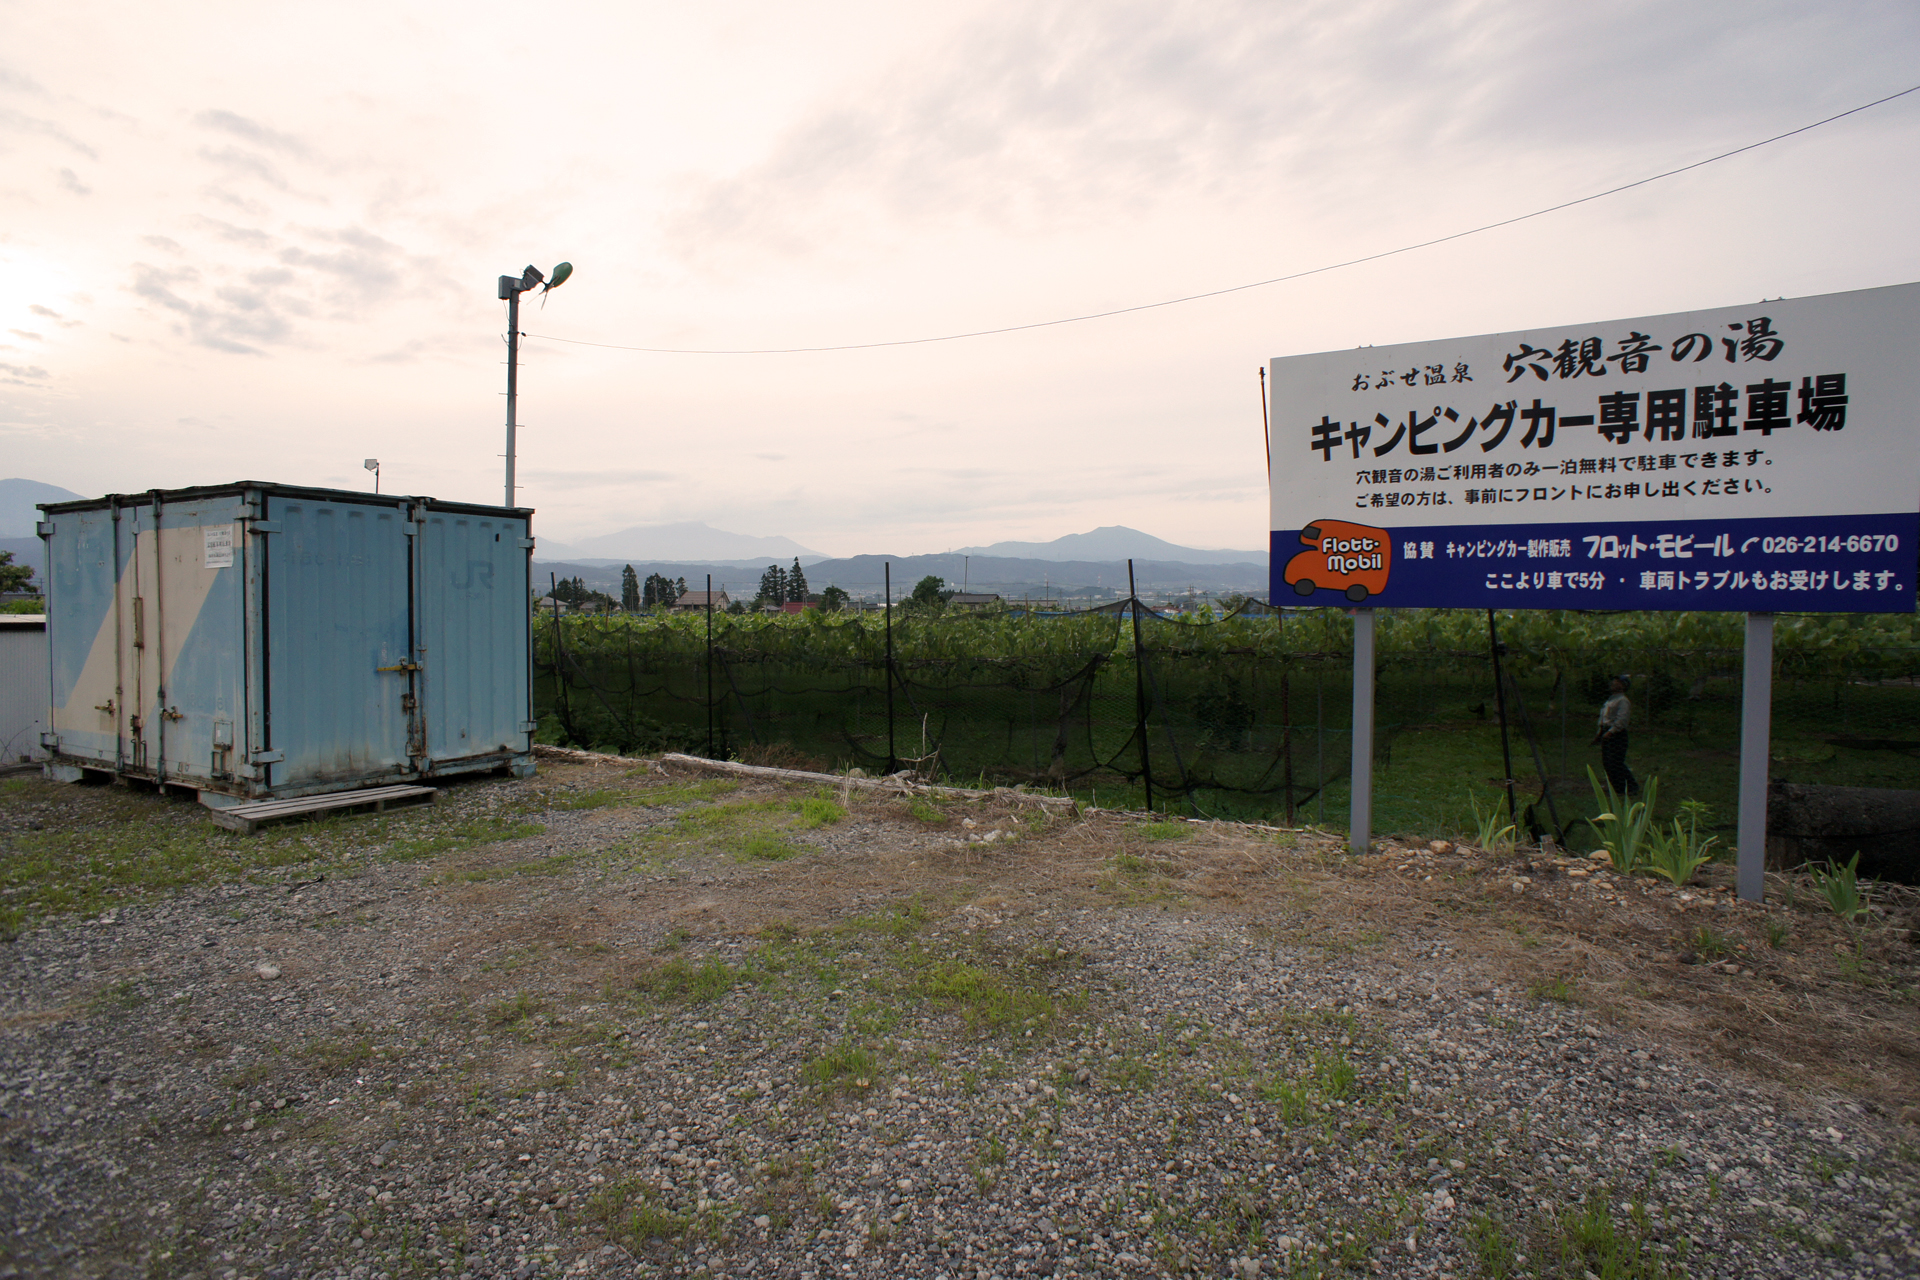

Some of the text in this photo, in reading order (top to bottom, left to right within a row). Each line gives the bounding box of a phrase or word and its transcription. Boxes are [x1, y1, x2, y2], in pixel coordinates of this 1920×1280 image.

[1351, 316, 1785, 392] おぶせ温泉 穴観音の湯
[1310, 372, 1849, 462] キャンピングカー専用駐車場
[1355, 449, 1773, 485] 穴観音の湯ご利用者のみ一泊無料で駐車できます。
[1355, 477, 1772, 509] ご希望の方は、事前にフロントにお申し出ください。
[1403, 533, 1899, 559] 協賛 キャンピングカー製作販売 フロット・モビール 026-214-6670
[449, 560, 495, 590] JR
[1327, 553, 1382, 574] Mobil
[1485, 570, 1606, 590] ここより車で5分
[1639, 569, 1903, 591] 車両トラブルもお受けします。
